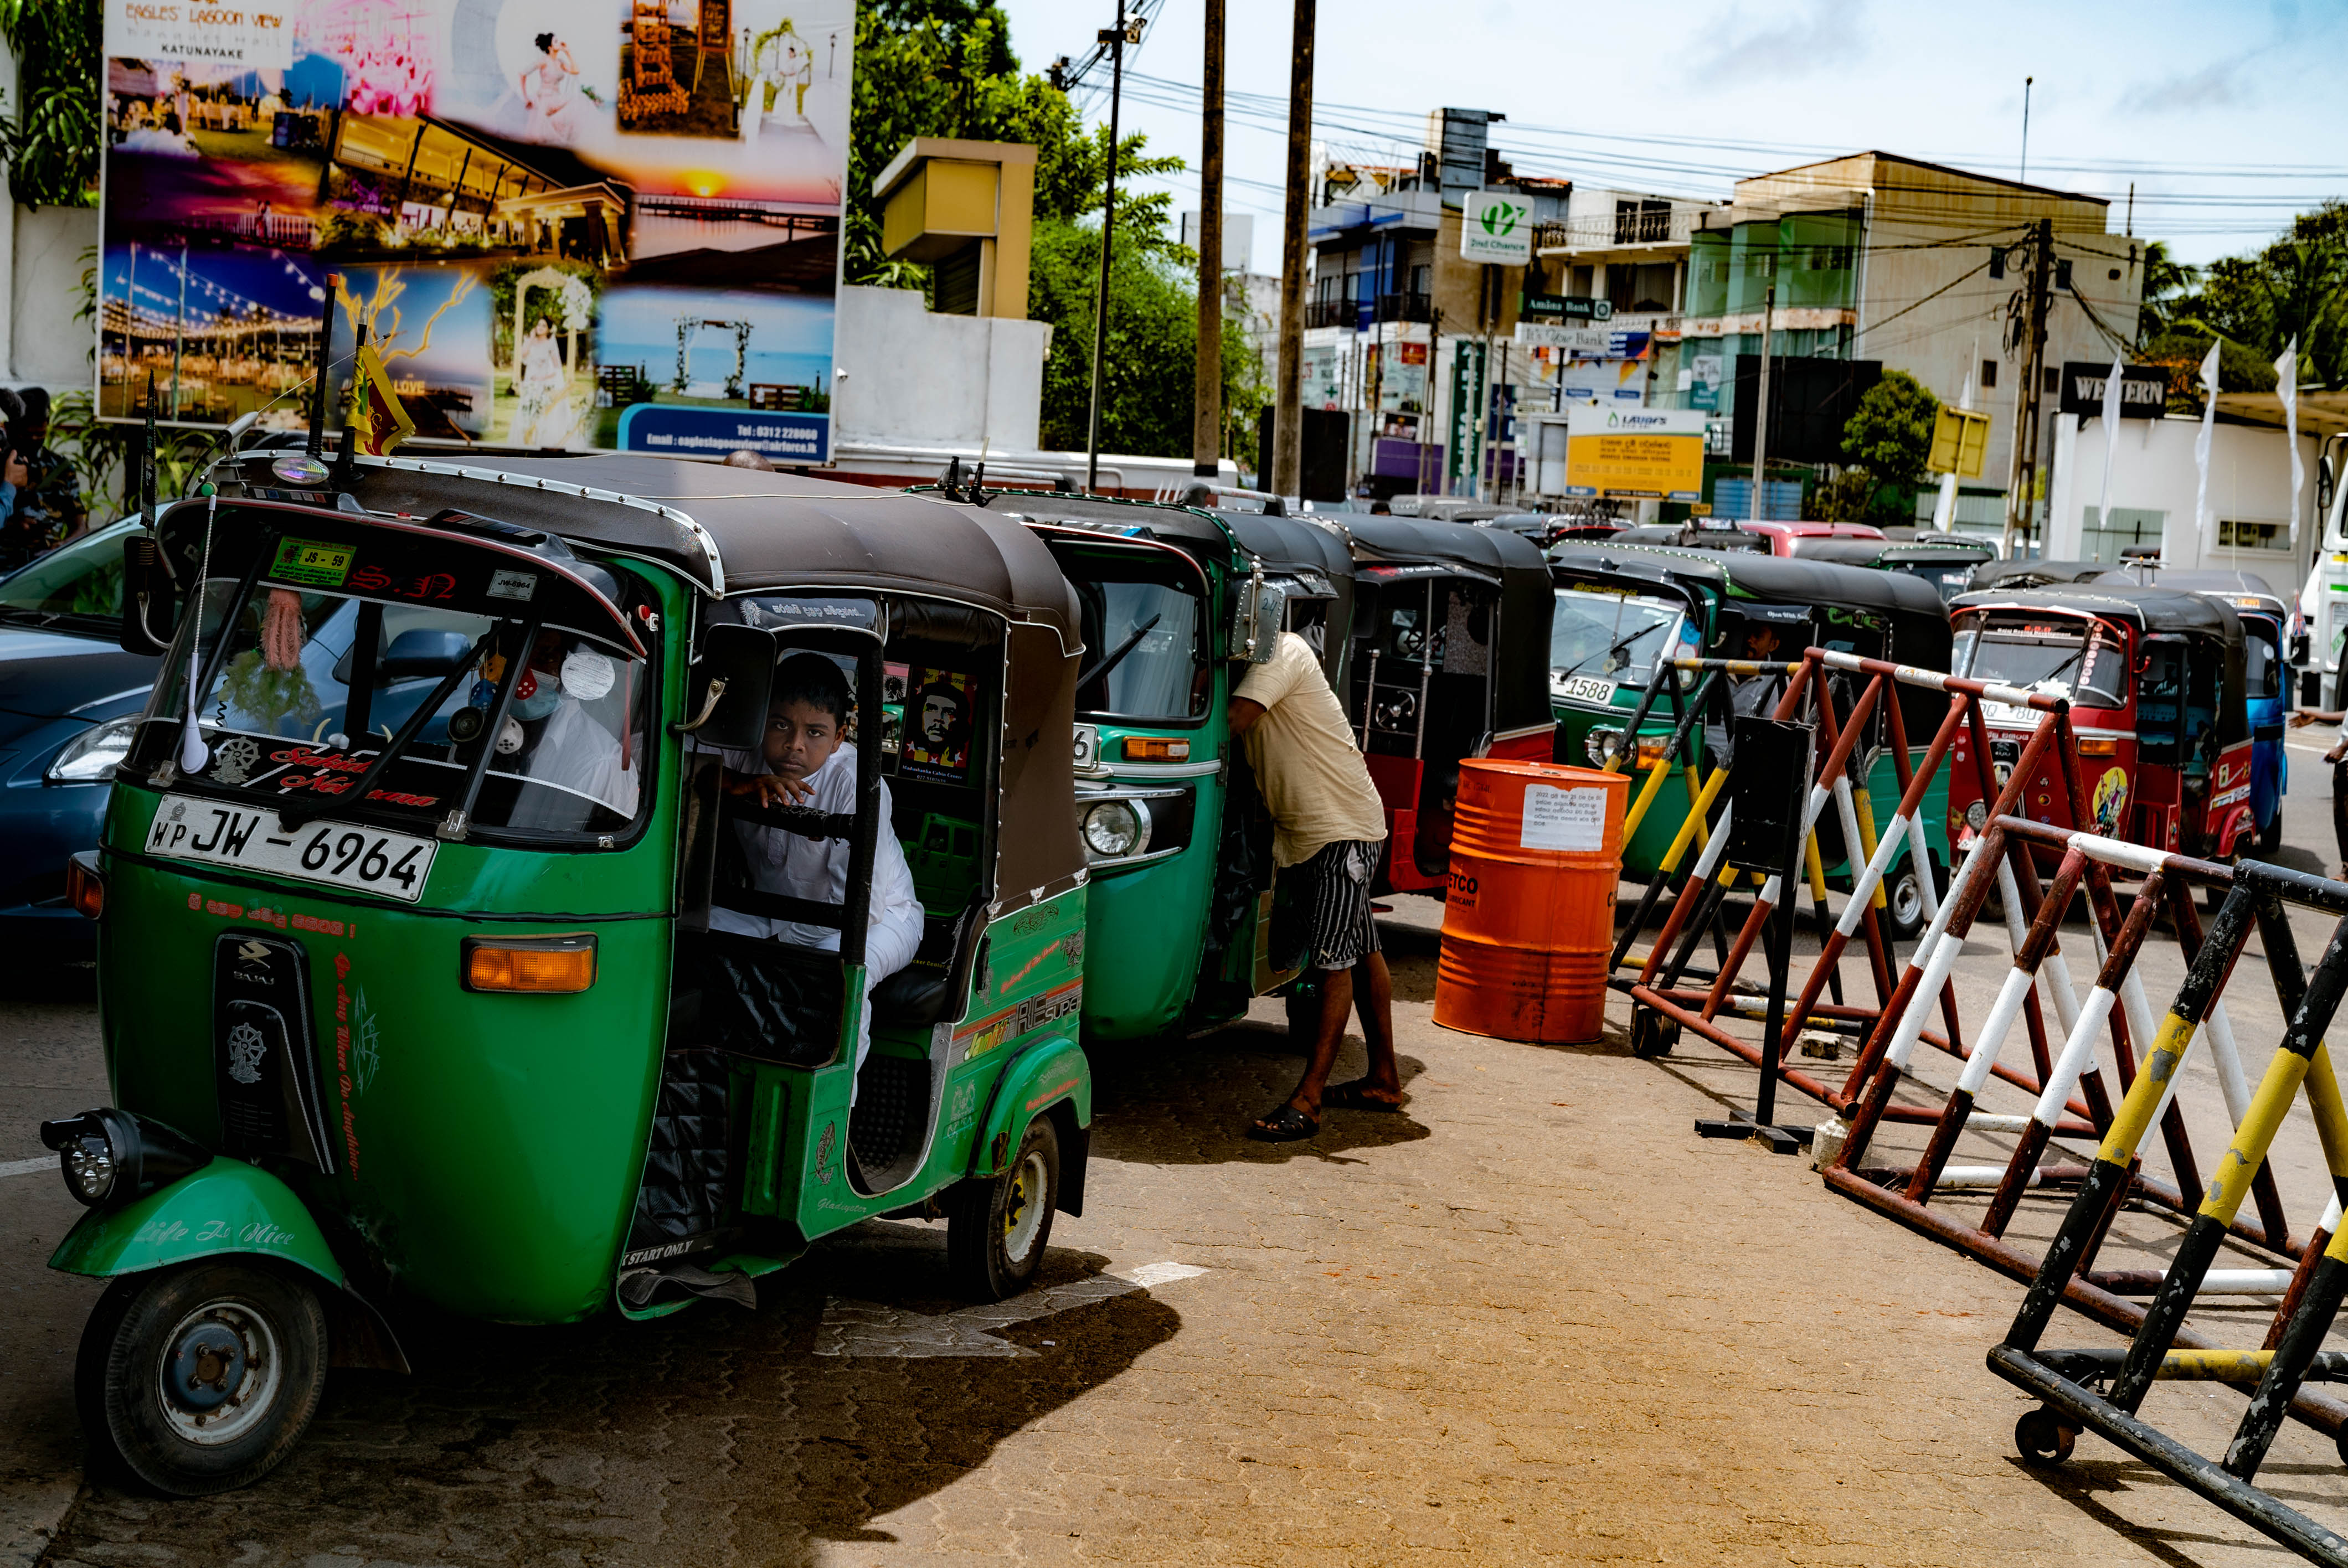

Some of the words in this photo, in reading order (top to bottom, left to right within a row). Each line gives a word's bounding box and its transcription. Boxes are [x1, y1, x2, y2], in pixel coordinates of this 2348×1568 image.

[189, 8, 243, 29] LAGOON
[251, 13, 282, 28] VIEW
[161, 44, 244, 59] KATUNAYAKE
[1471, 239, 1489, 249] 2nd
[1490, 240, 1526, 251] Chance
[1566, 301, 1590, 313] Bank
[1575, 332, 1604, 346] Bank
[2074, 376, 2164, 405] WEERN
[647, 433, 673, 446] Email
[738, 425, 752, 436] Tel
[1261, 597, 1278, 618] 24
[152, 821, 187, 849] WP
[233, 971, 275, 986] BAJAJ
[336, 1024, 351, 1072] Where
[964, 1018, 1010, 1062] Janith
[134, 1219, 190, 1247] Life
[195, 1220, 233, 1241] Is
[239, 1222, 296, 1246] Nice
[627, 1247, 665, 1266] START
[663, 1240, 694, 1258] ONLY
